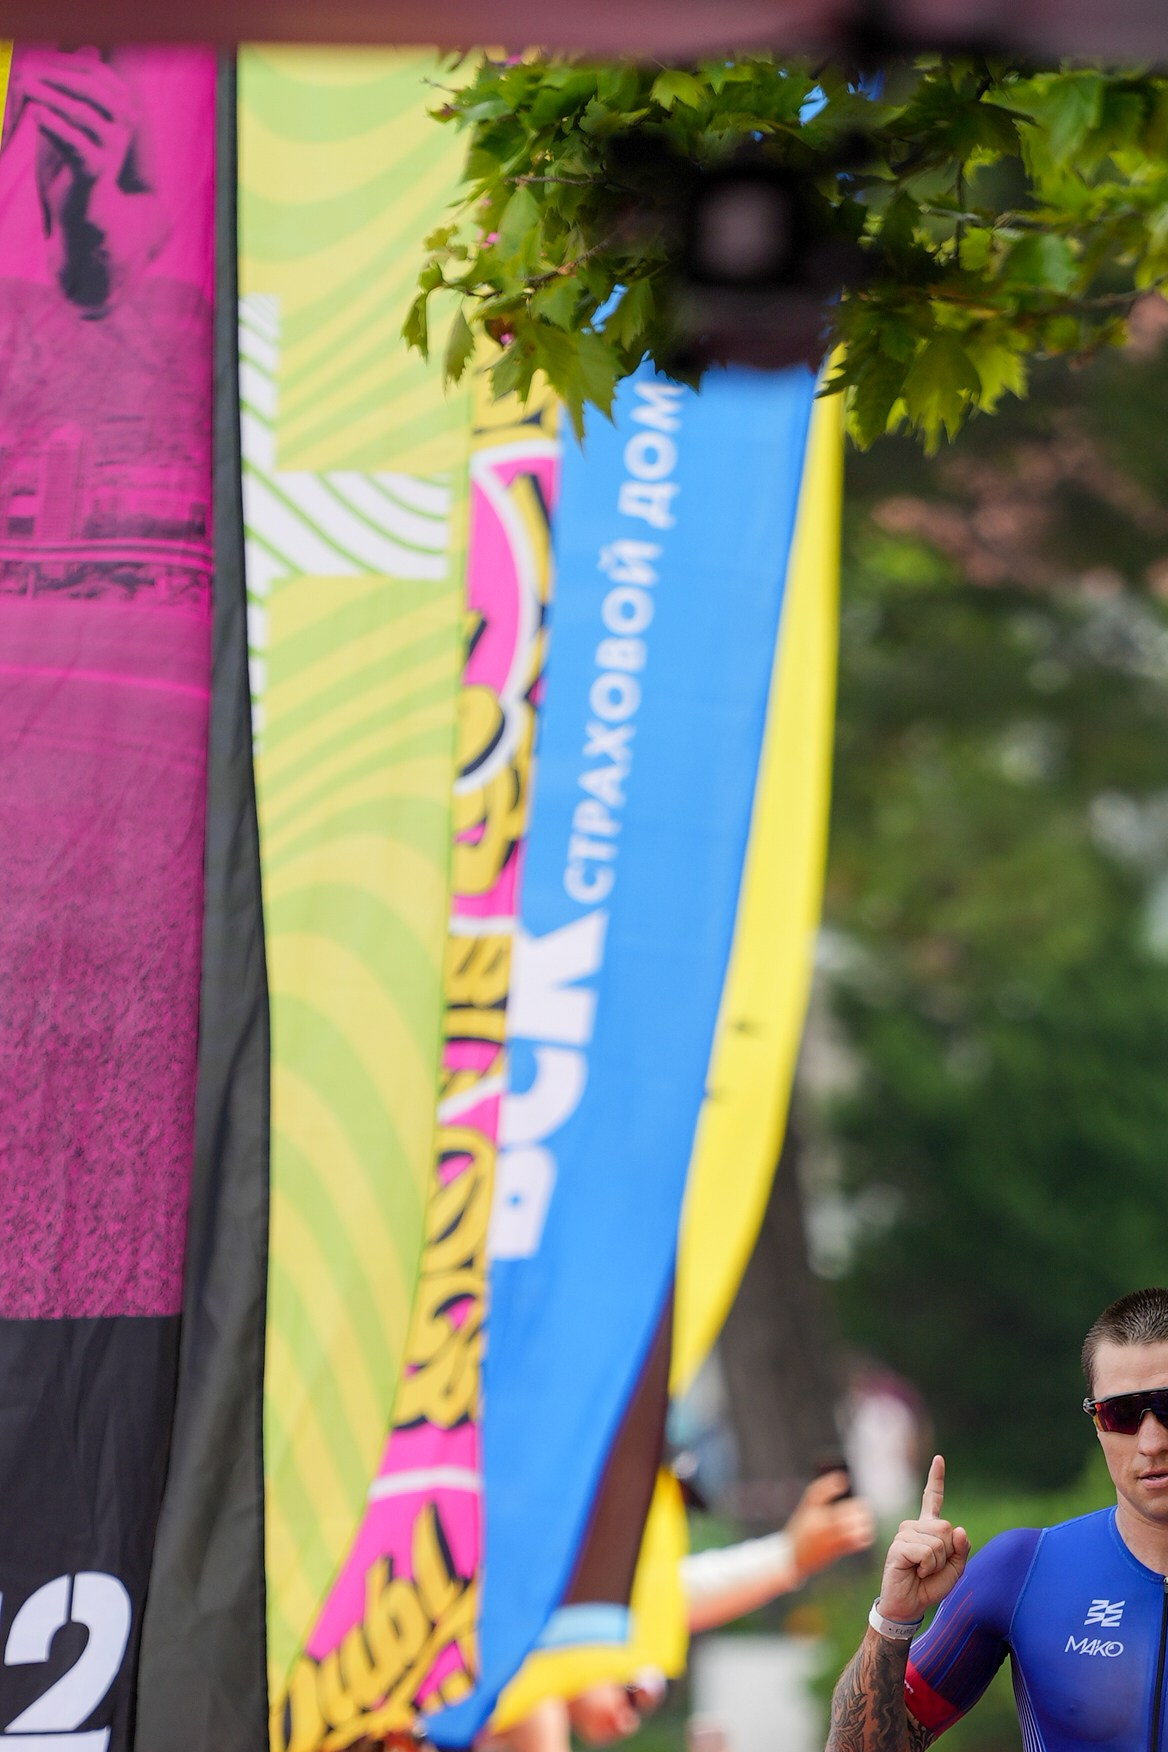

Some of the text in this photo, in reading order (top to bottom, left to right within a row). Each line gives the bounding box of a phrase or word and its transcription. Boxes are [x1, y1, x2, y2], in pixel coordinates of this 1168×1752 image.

[564, 538, 664, 905] СТРАХОВОЙ
[617, 381, 683, 530] ДОМ
[1065, 1635, 1124, 1658] MAKO
